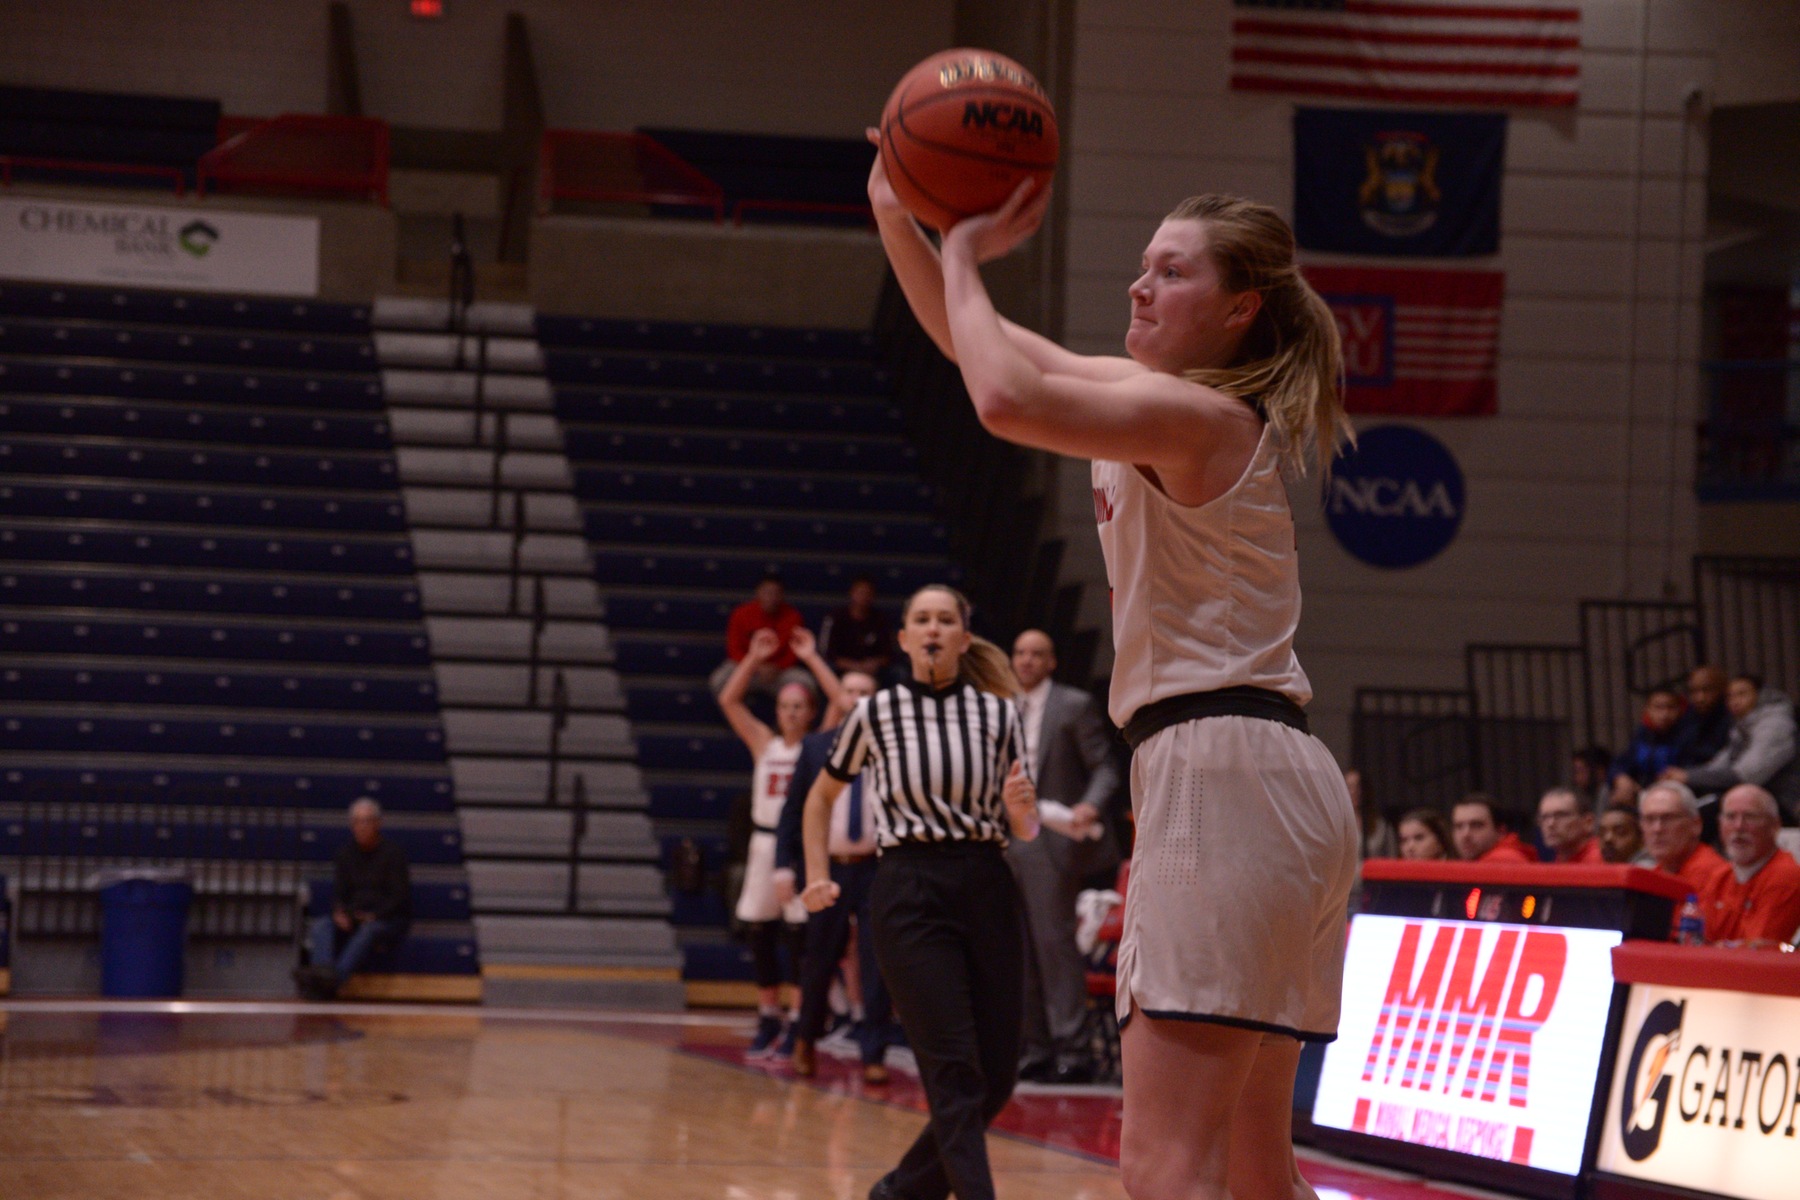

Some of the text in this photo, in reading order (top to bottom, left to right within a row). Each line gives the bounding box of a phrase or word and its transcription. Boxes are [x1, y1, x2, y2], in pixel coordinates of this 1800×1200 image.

[962, 101, 1043, 137] NCAA
[19, 206, 169, 235] CHEMICAL
[1331, 475, 1457, 517] NCAA
